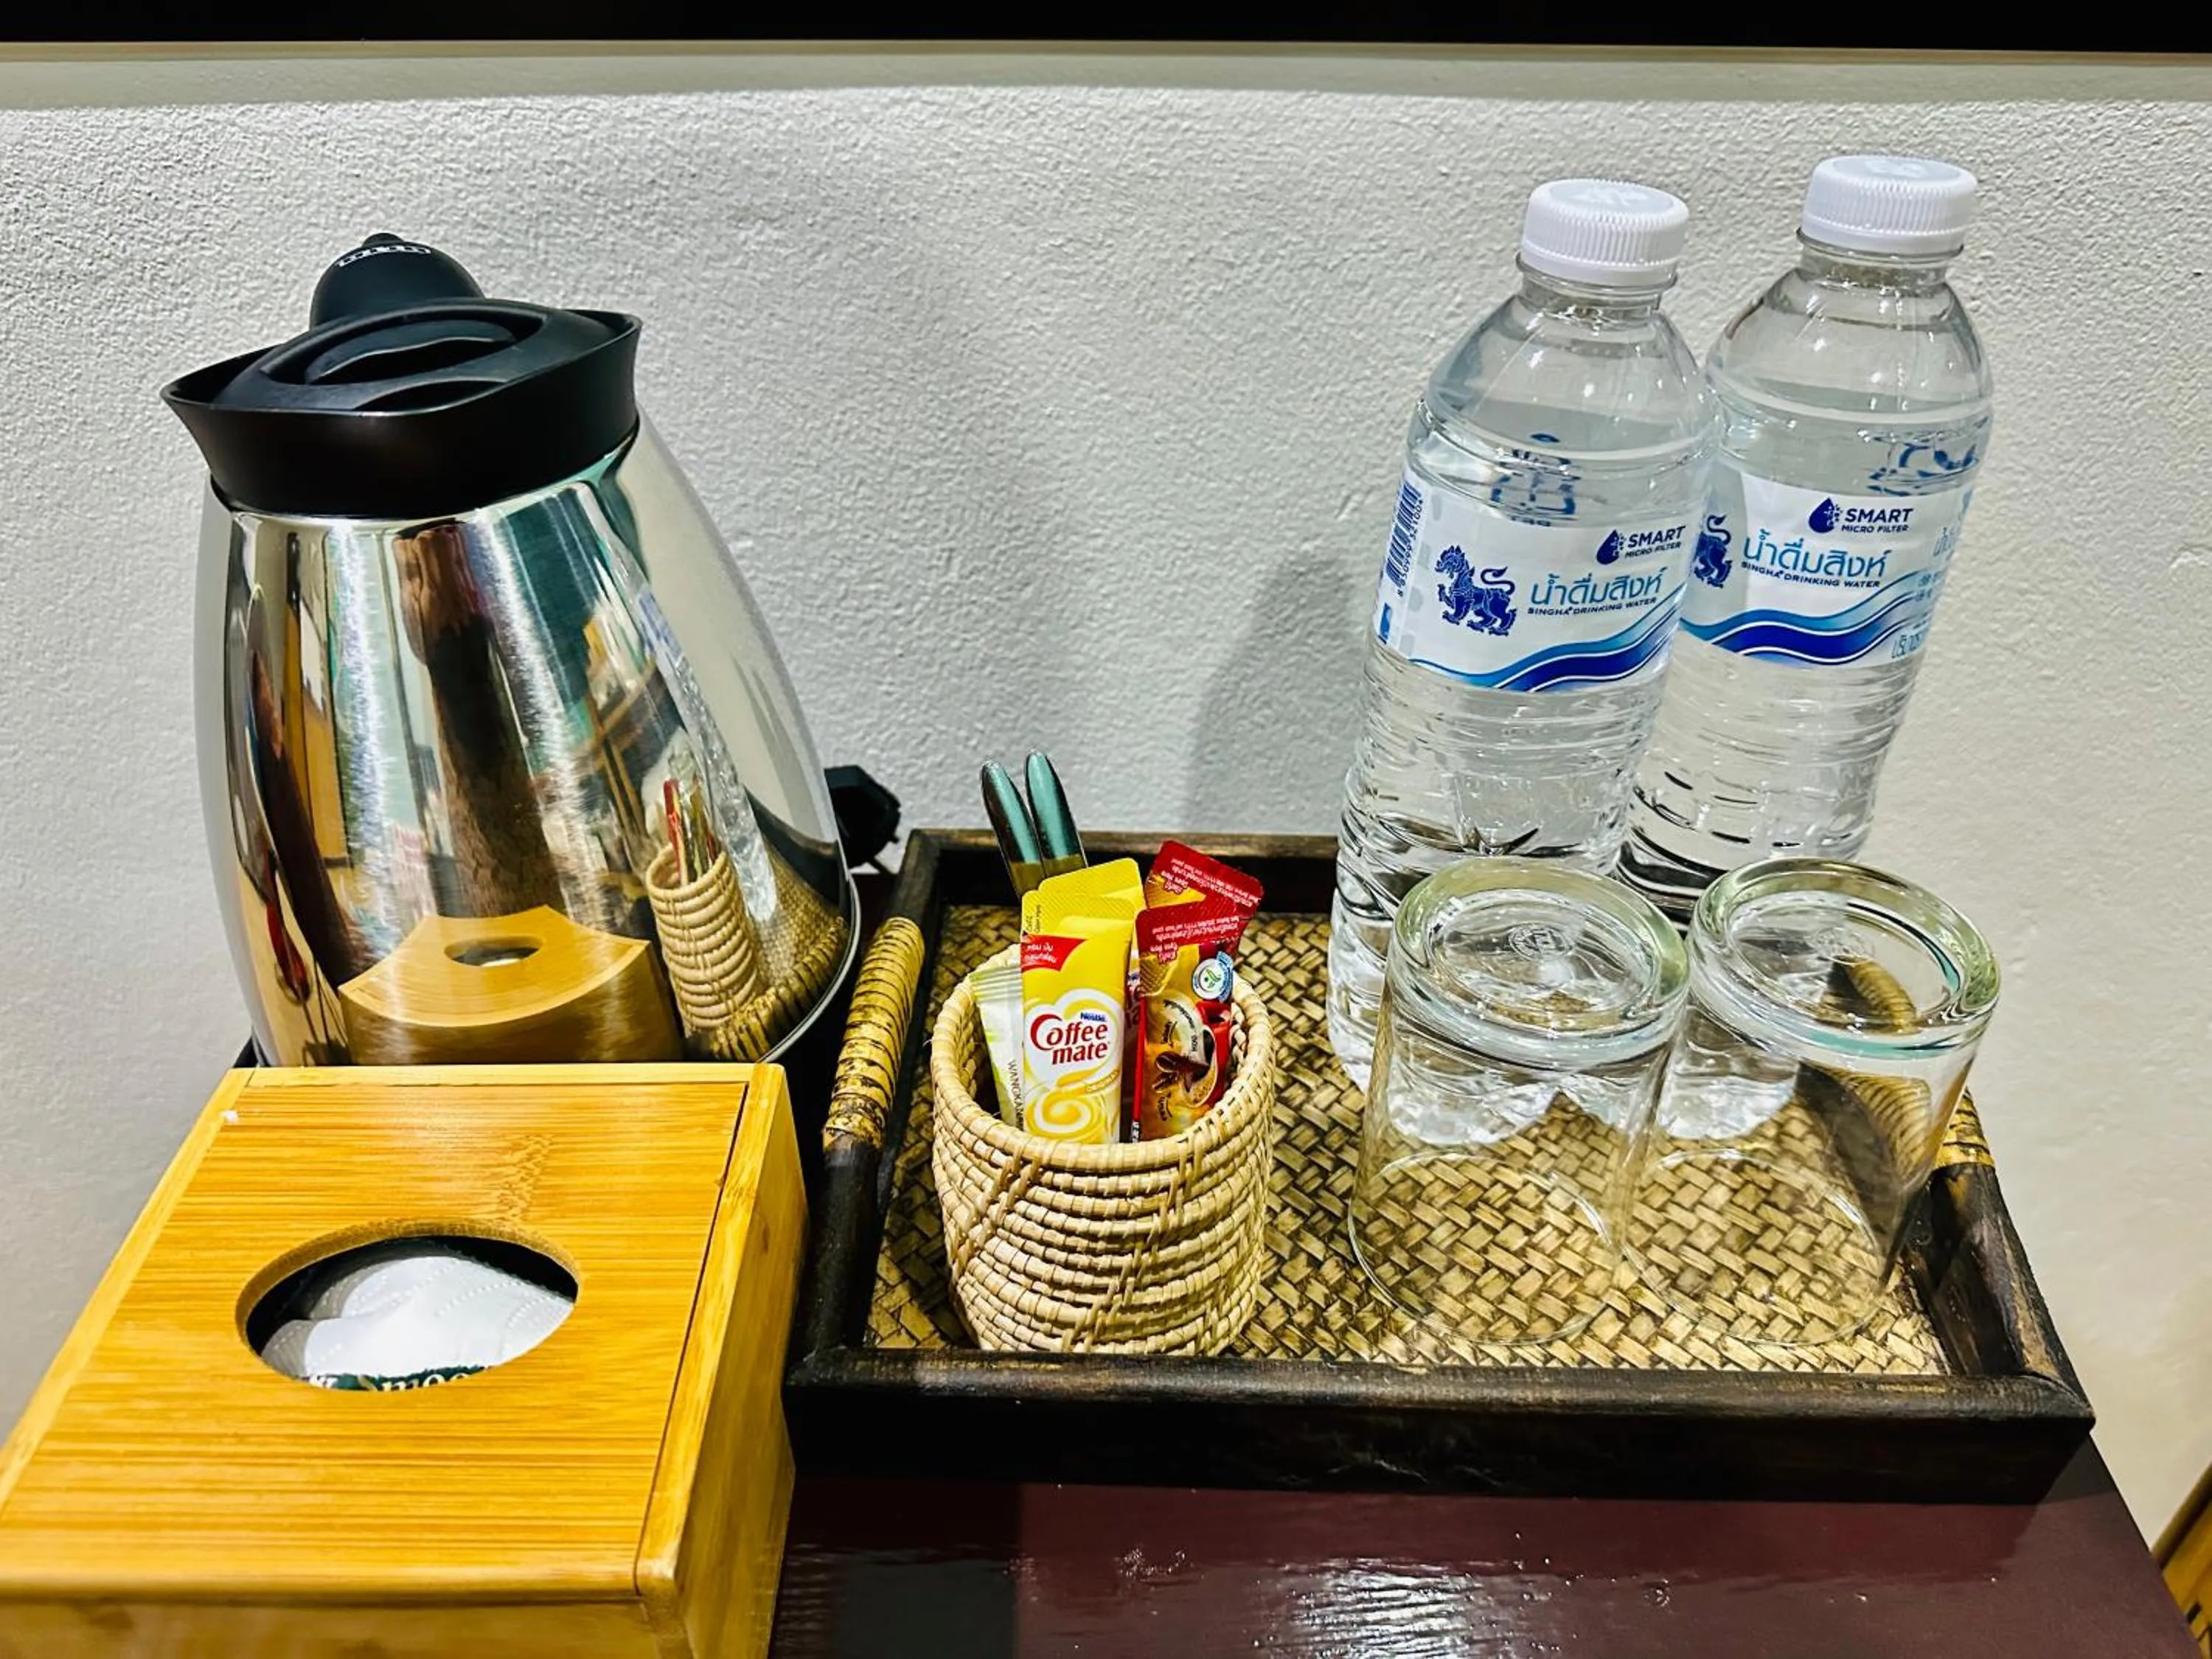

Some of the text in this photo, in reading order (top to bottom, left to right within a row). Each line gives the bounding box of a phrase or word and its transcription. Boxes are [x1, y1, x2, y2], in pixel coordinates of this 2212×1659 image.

[1845, 507, 1915, 524] SMART
[1627, 524, 1686, 549] SMART
[1841, 524, 1910, 534] MICRO FILTER
[1624, 540, 1682, 558] MICRO FILTER
[1743, 528, 1893, 578] น้ำดื่มสิงห์
[1530, 566, 1668, 605] น้ำดื่มสิงห์
[1783, 572, 1841, 588] DRINKING
[1843, 580, 1882, 588] WATER
[1573, 602, 1622, 614] DRINKING
[1625, 597, 1657, 608] WATER
[1030, 1013, 1108, 1051] Coffee
[1051, 1042, 1108, 1065] mate
[1008, 1059, 1024, 1133] WANGKAN
